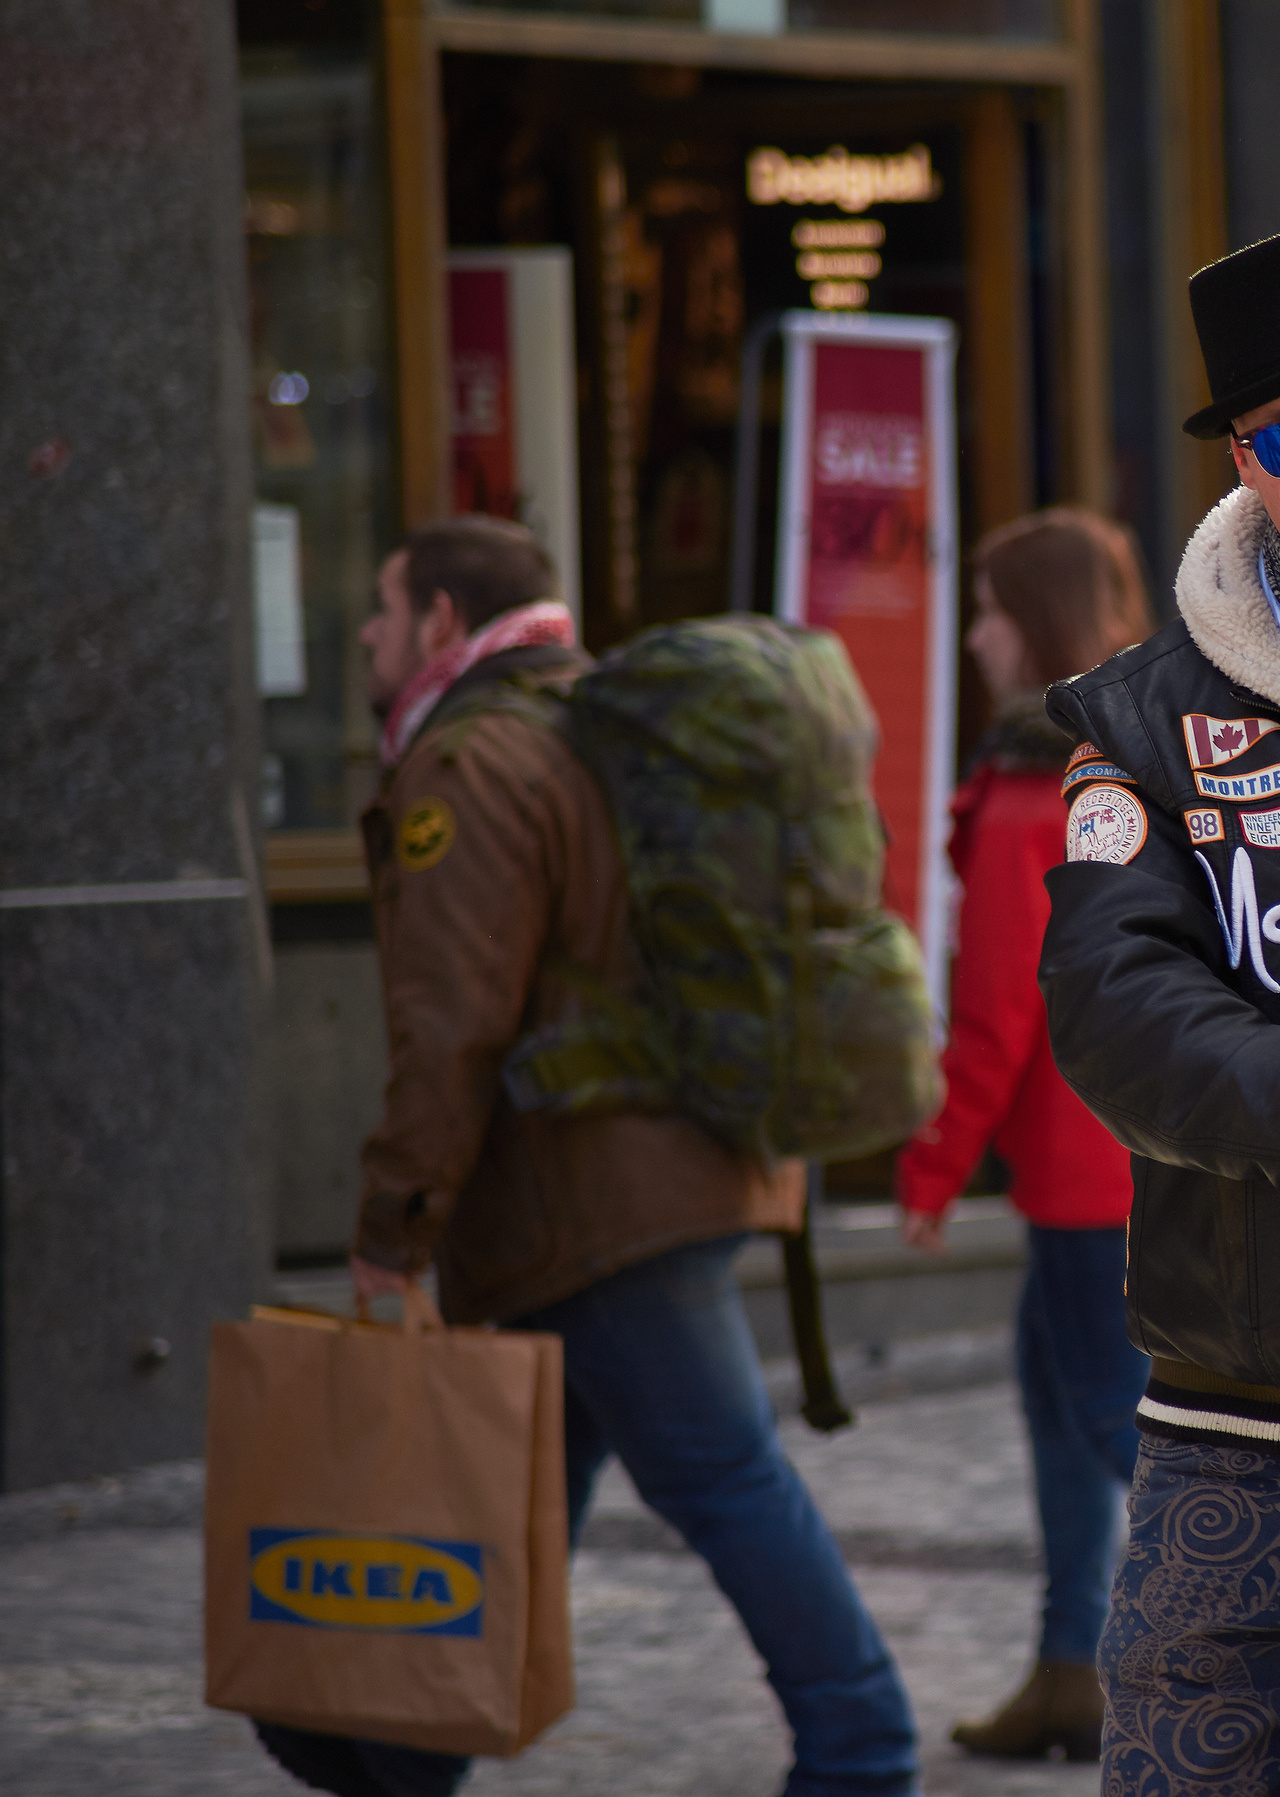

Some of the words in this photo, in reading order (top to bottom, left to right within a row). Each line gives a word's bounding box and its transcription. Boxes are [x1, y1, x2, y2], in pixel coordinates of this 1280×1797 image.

[1086, 767, 1132, 777] COMPA
[1189, 813, 1218, 840] 98
[284, 1557, 454, 1604] IKEA
